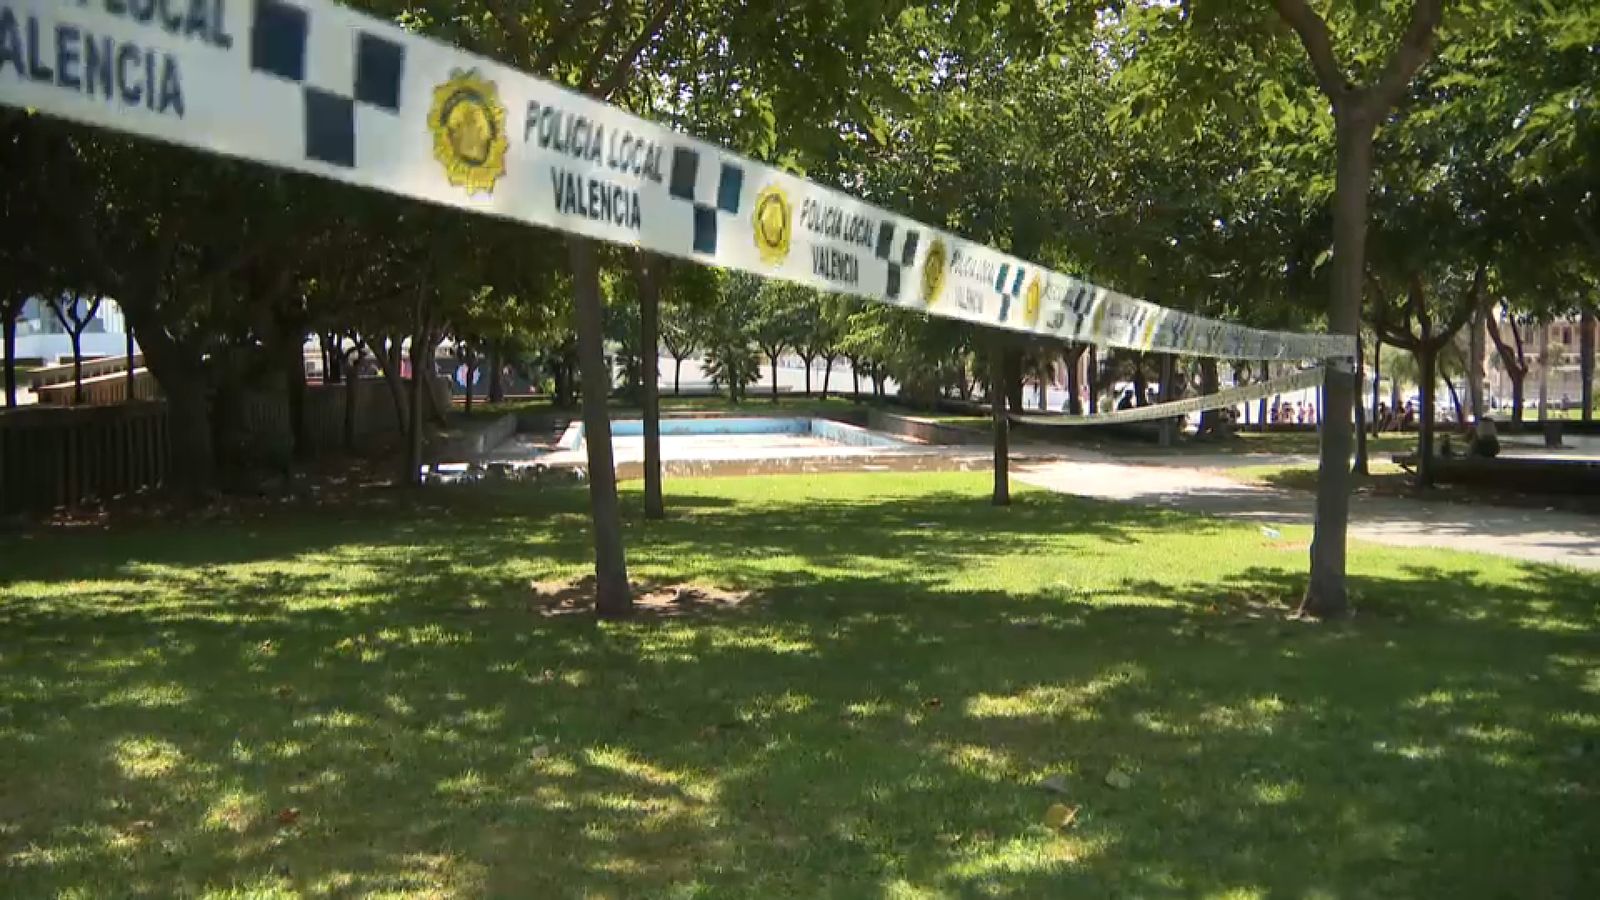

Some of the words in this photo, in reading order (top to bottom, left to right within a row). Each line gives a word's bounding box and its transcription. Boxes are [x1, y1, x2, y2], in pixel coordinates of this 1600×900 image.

[104, 0, 233, 50] CAL
[524, 100, 604, 164] POLICIA
[606, 128, 663, 184] LOCAL
[551, 166, 641, 230] VALENCIA
